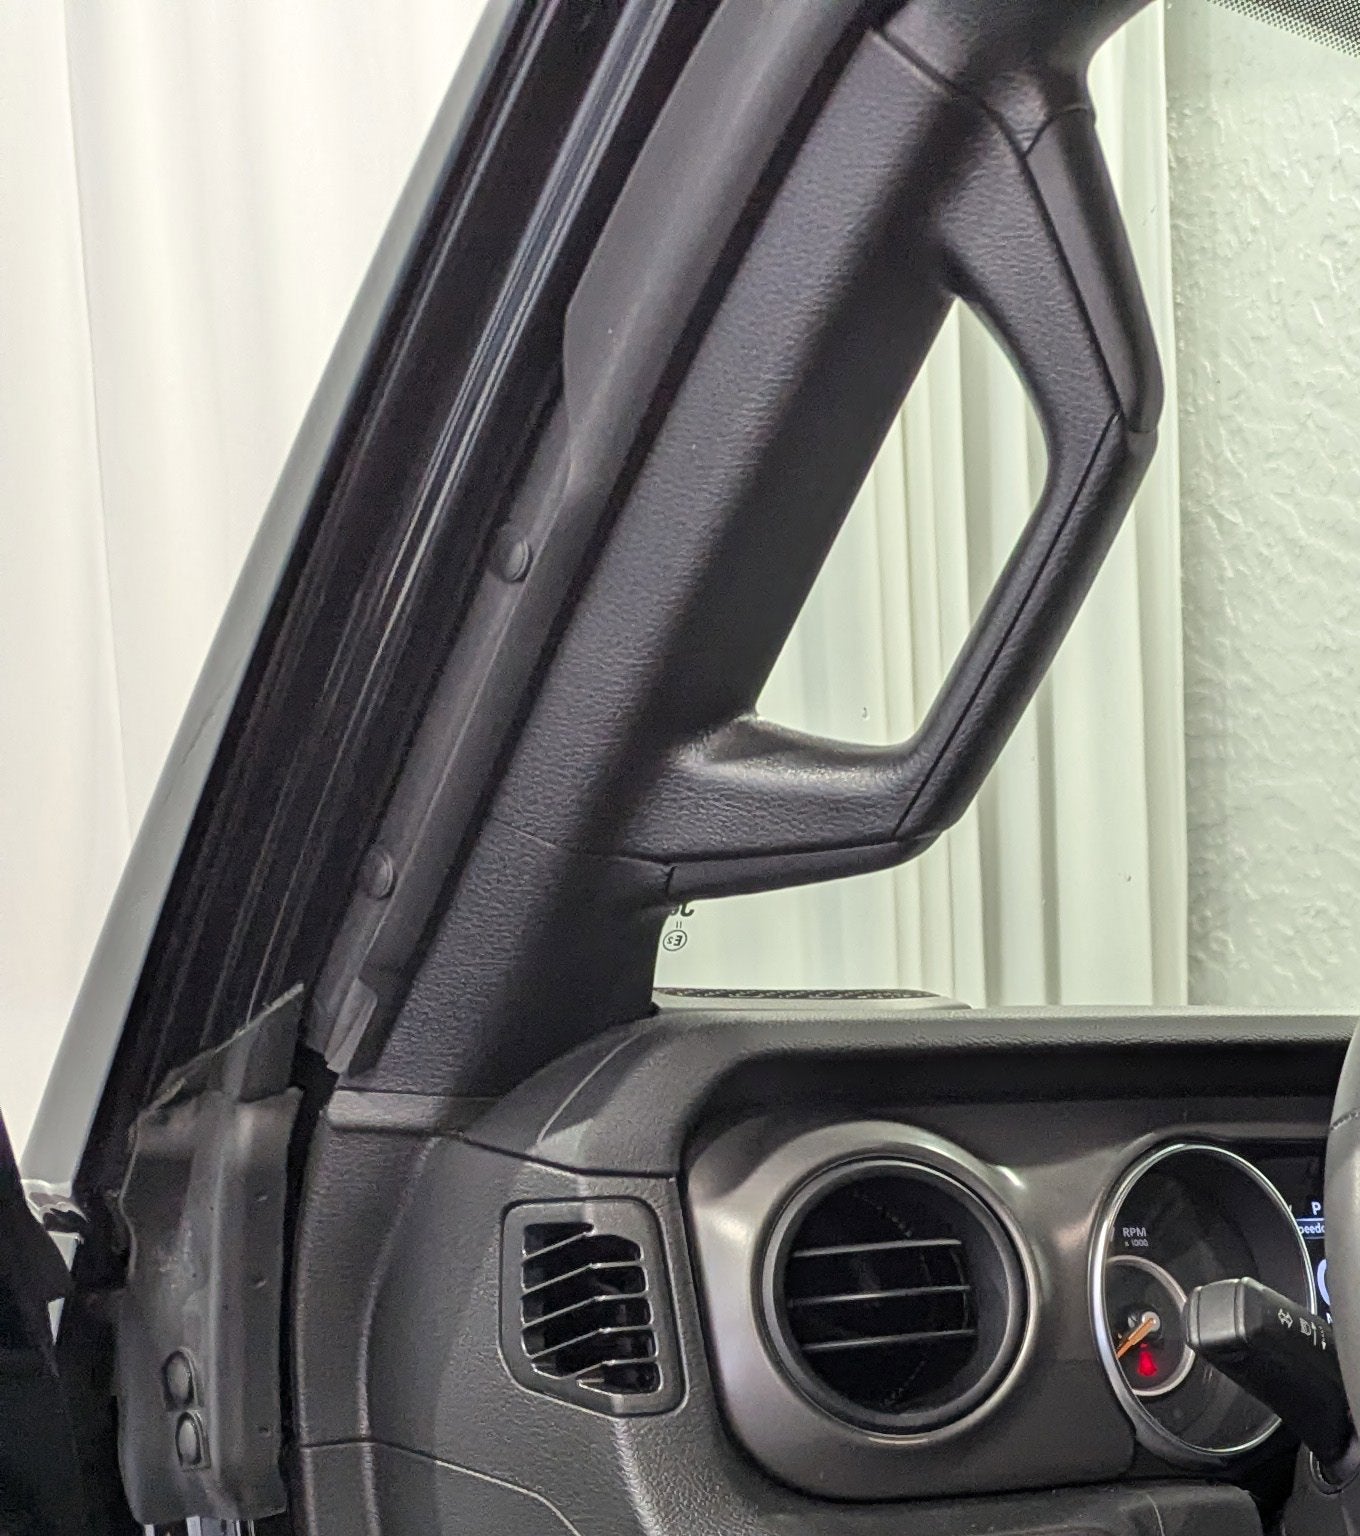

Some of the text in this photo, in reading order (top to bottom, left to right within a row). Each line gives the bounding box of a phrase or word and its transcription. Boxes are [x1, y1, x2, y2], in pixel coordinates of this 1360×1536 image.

[1311, 1201, 1321, 1215] P
[1123, 1227, 1147, 1238] RPM
[1131, 1239, 1148, 1247] 1000
